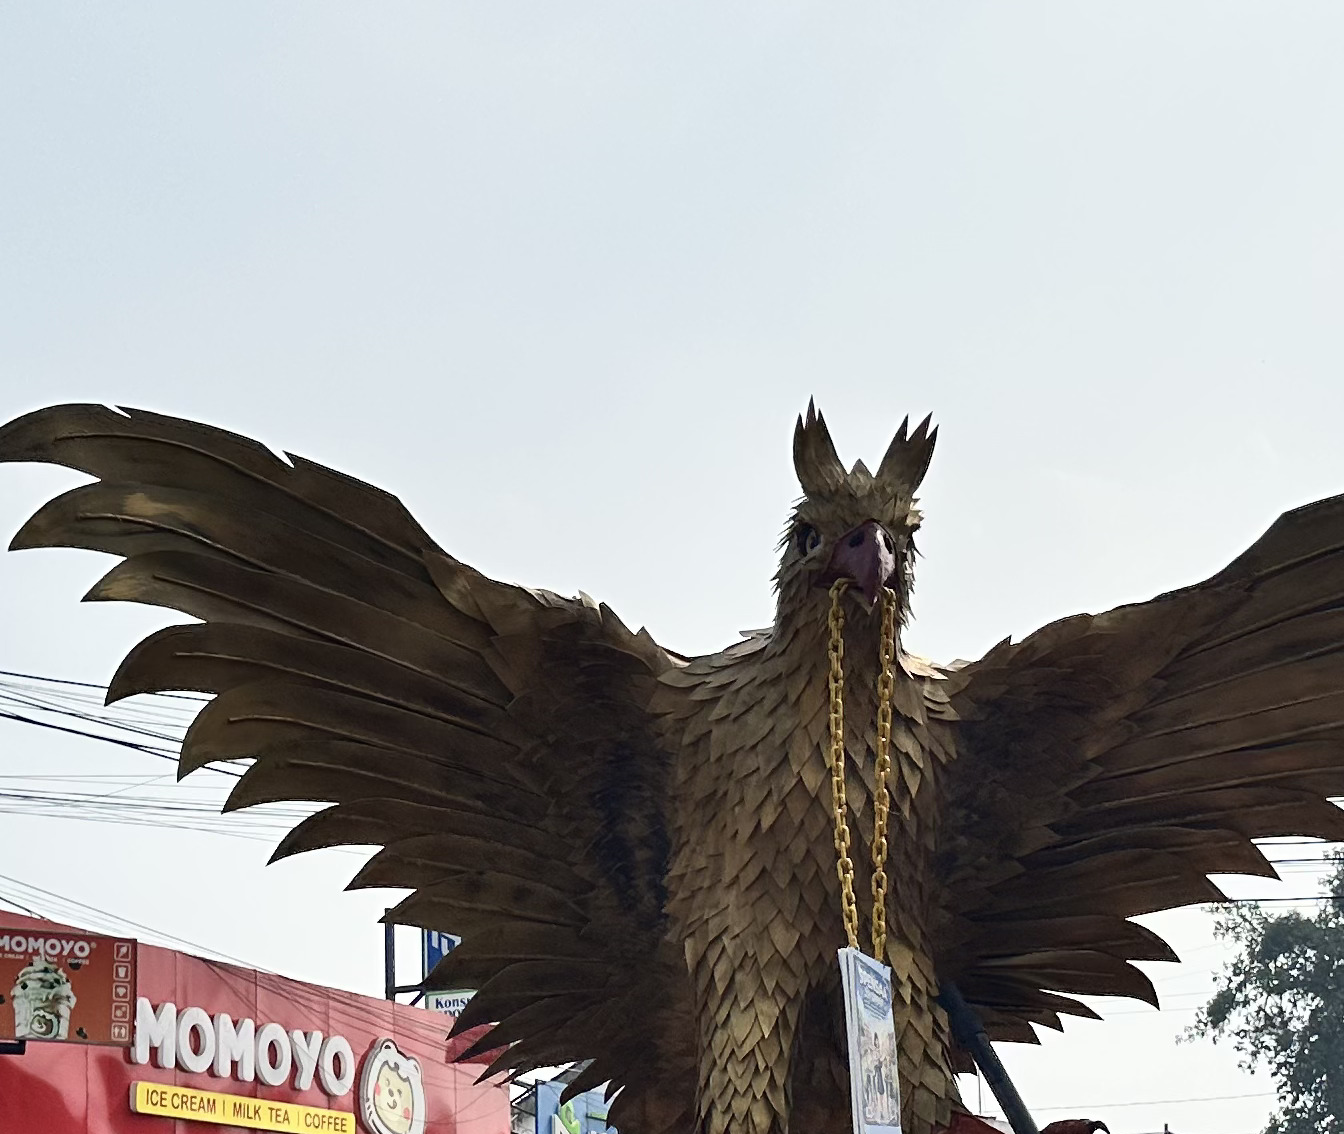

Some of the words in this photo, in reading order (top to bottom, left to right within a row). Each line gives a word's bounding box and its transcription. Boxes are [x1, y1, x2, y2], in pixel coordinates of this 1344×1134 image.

[131, 997, 355, 1096] MOMOYO
[146, 1089, 167, 1108] ICE
[171, 1094, 216, 1114] CREAM
[233, 1103, 261, 1121] MILK
[269, 1107, 290, 1125] TEA
[305, 1113, 347, 1133] COFFEE
